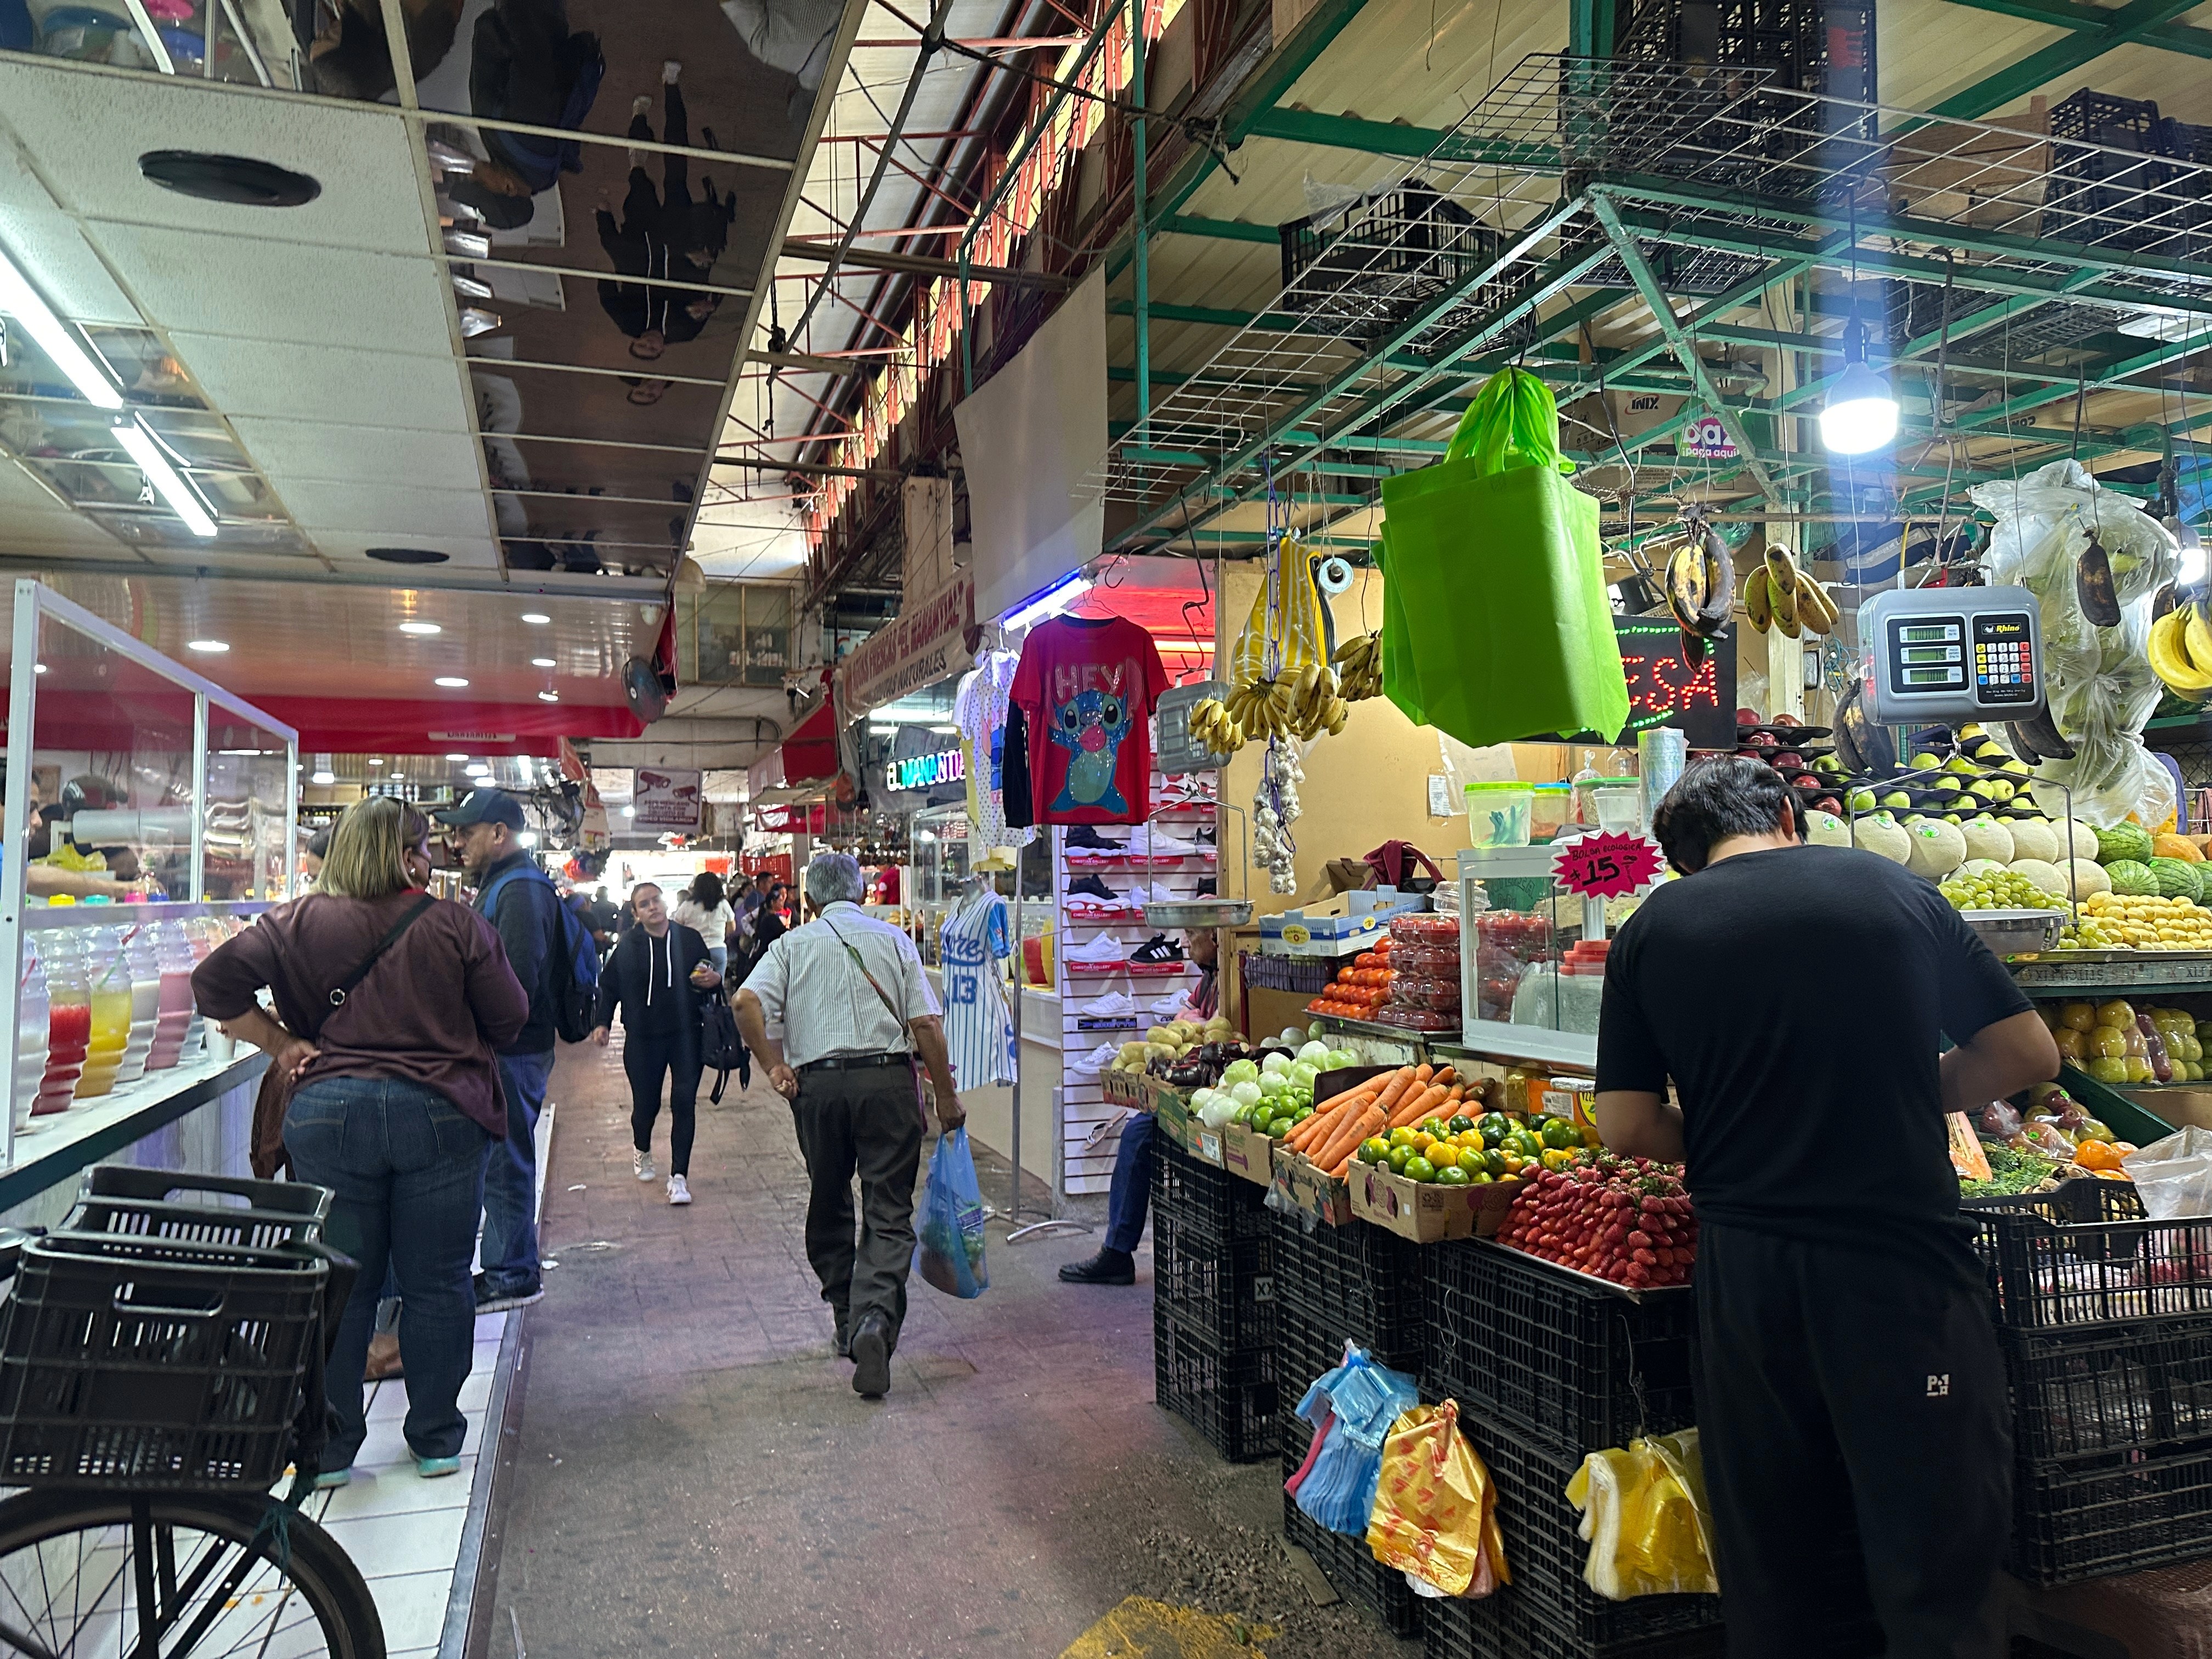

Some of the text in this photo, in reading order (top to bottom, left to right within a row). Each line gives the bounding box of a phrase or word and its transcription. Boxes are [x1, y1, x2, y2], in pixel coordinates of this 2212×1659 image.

[1996, 624, 2020, 633] Rhino
[898, 646, 947, 692] NATURALES
[1054, 663, 1124, 700] HEY
[1620, 656, 1719, 710] ESA
[899, 748, 966, 790] MANANTIA
[951, 973, 978, 1005] 13
